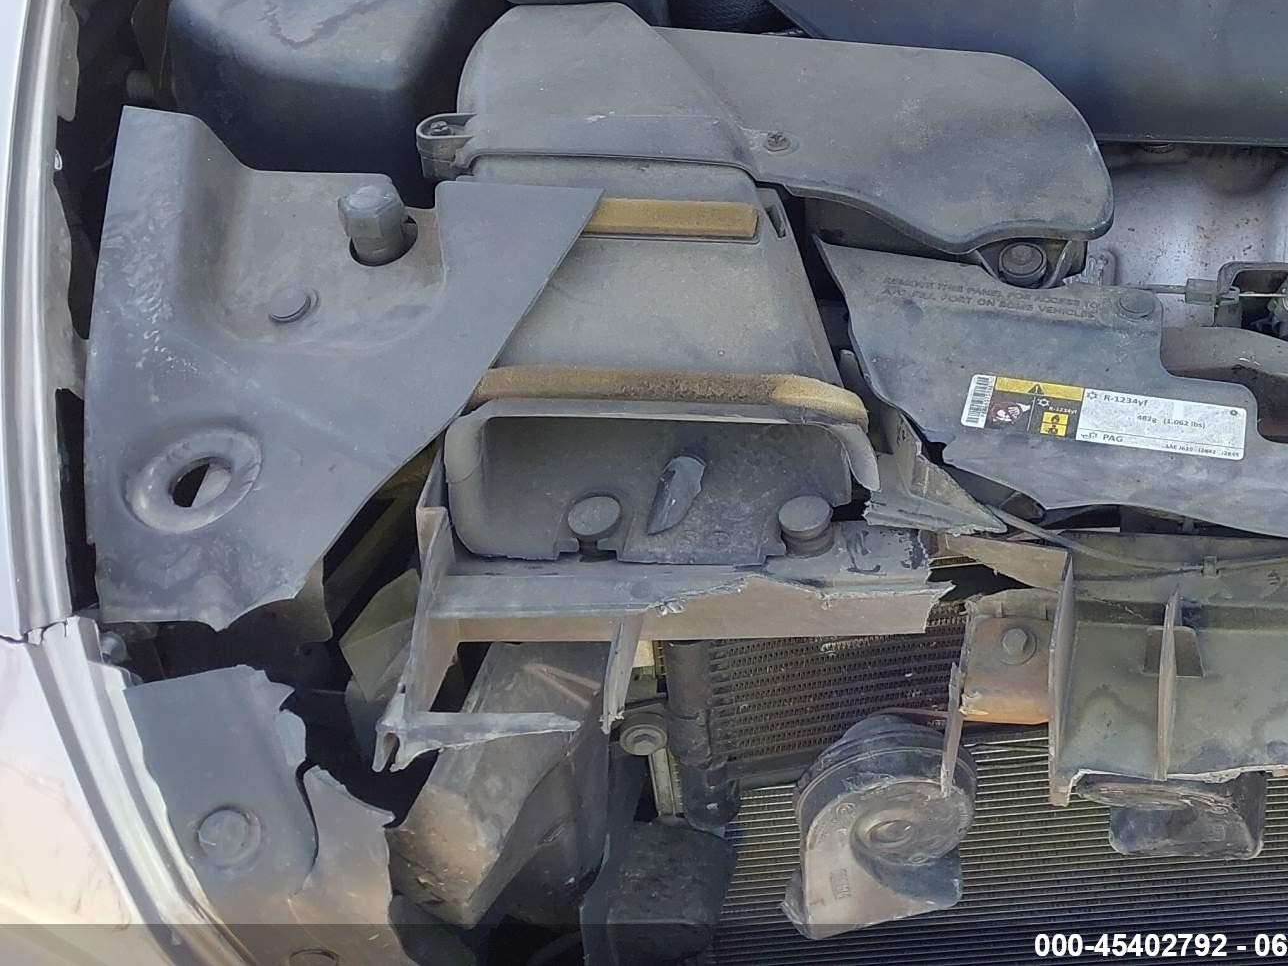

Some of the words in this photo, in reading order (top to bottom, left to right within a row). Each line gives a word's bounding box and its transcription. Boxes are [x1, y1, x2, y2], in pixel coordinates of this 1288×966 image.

[966, 286, 1001, 297] PANEL
[1006, 291, 1032, 301] FOR
[977, 297, 996, 307] ON
[1037, 304, 1097, 320] VEHICLES
[1102, 394, 1149, 407] R-1234yf
[1102, 434, 1124, 443] PAG
